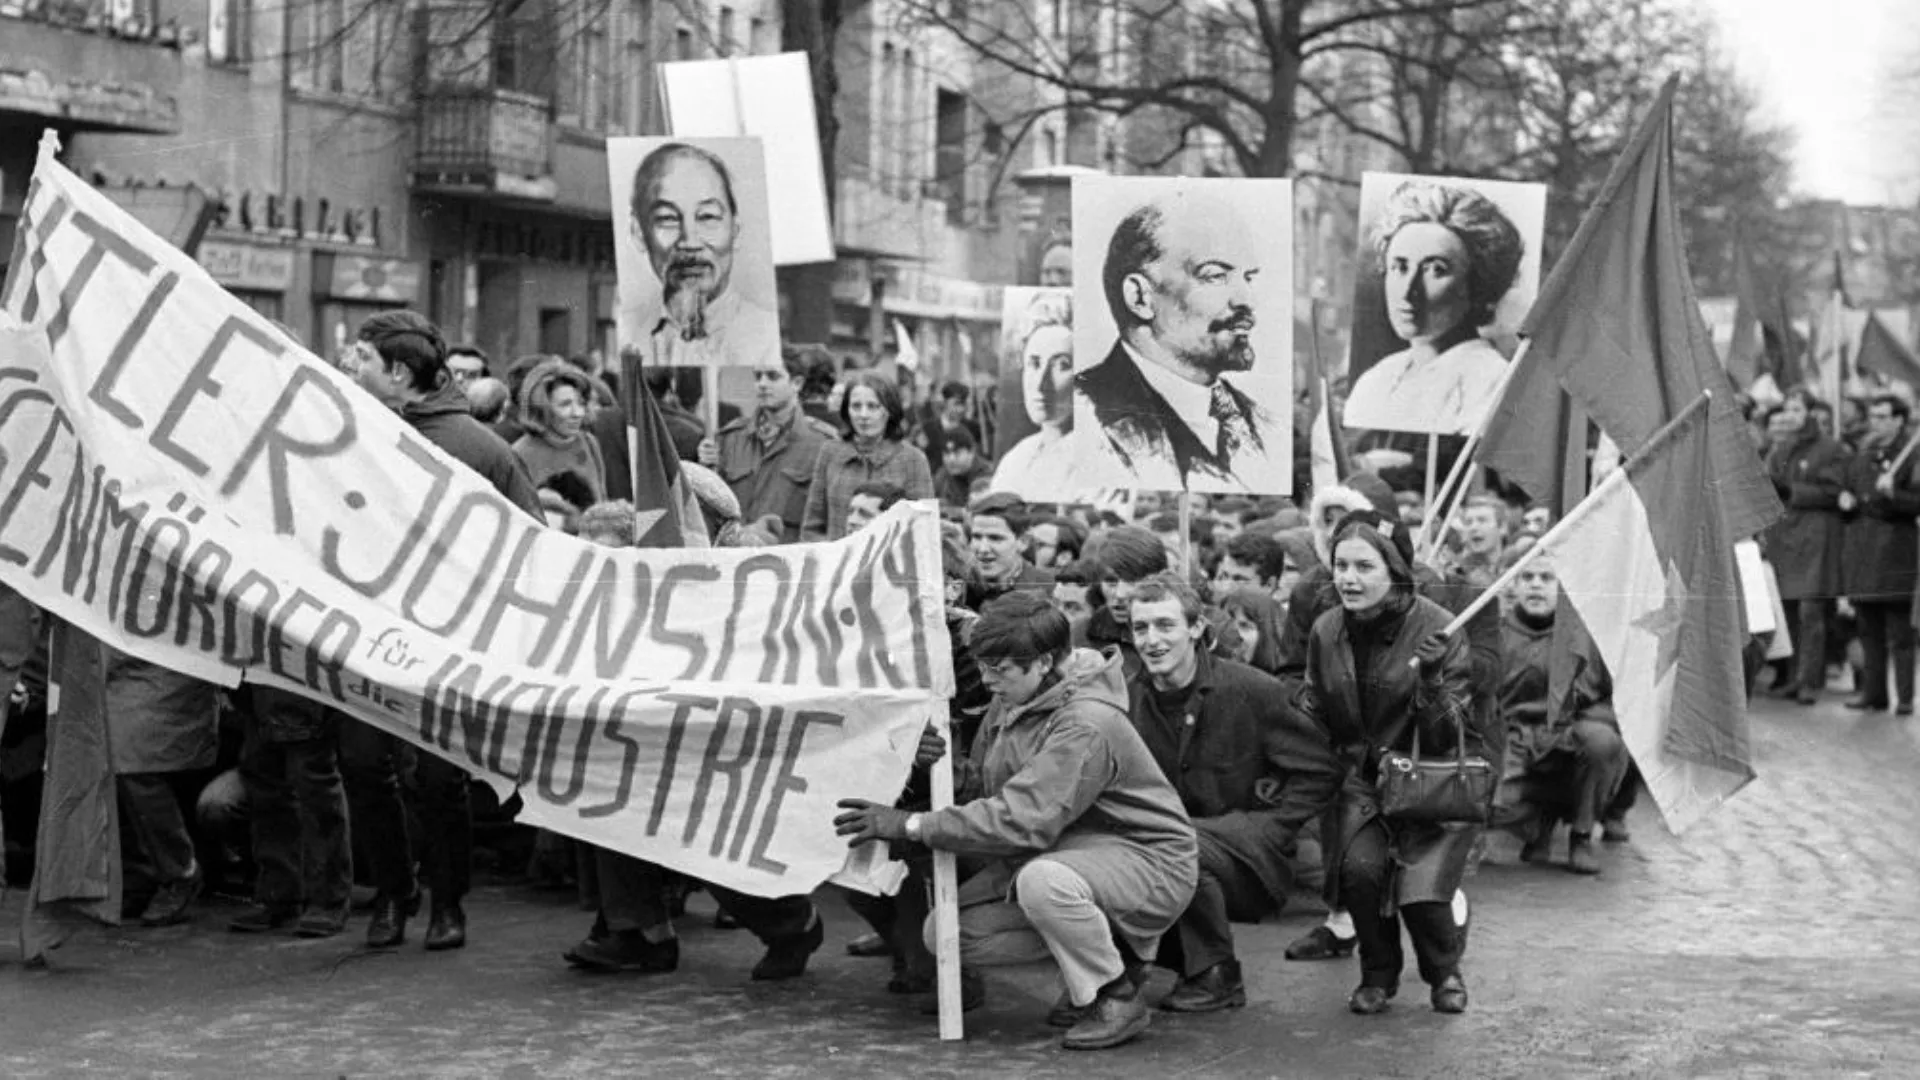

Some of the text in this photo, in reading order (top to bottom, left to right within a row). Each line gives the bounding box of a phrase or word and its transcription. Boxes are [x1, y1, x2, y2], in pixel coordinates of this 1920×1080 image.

[0, 367, 846, 876] ENMÖRDER für die INDUSTRIE
